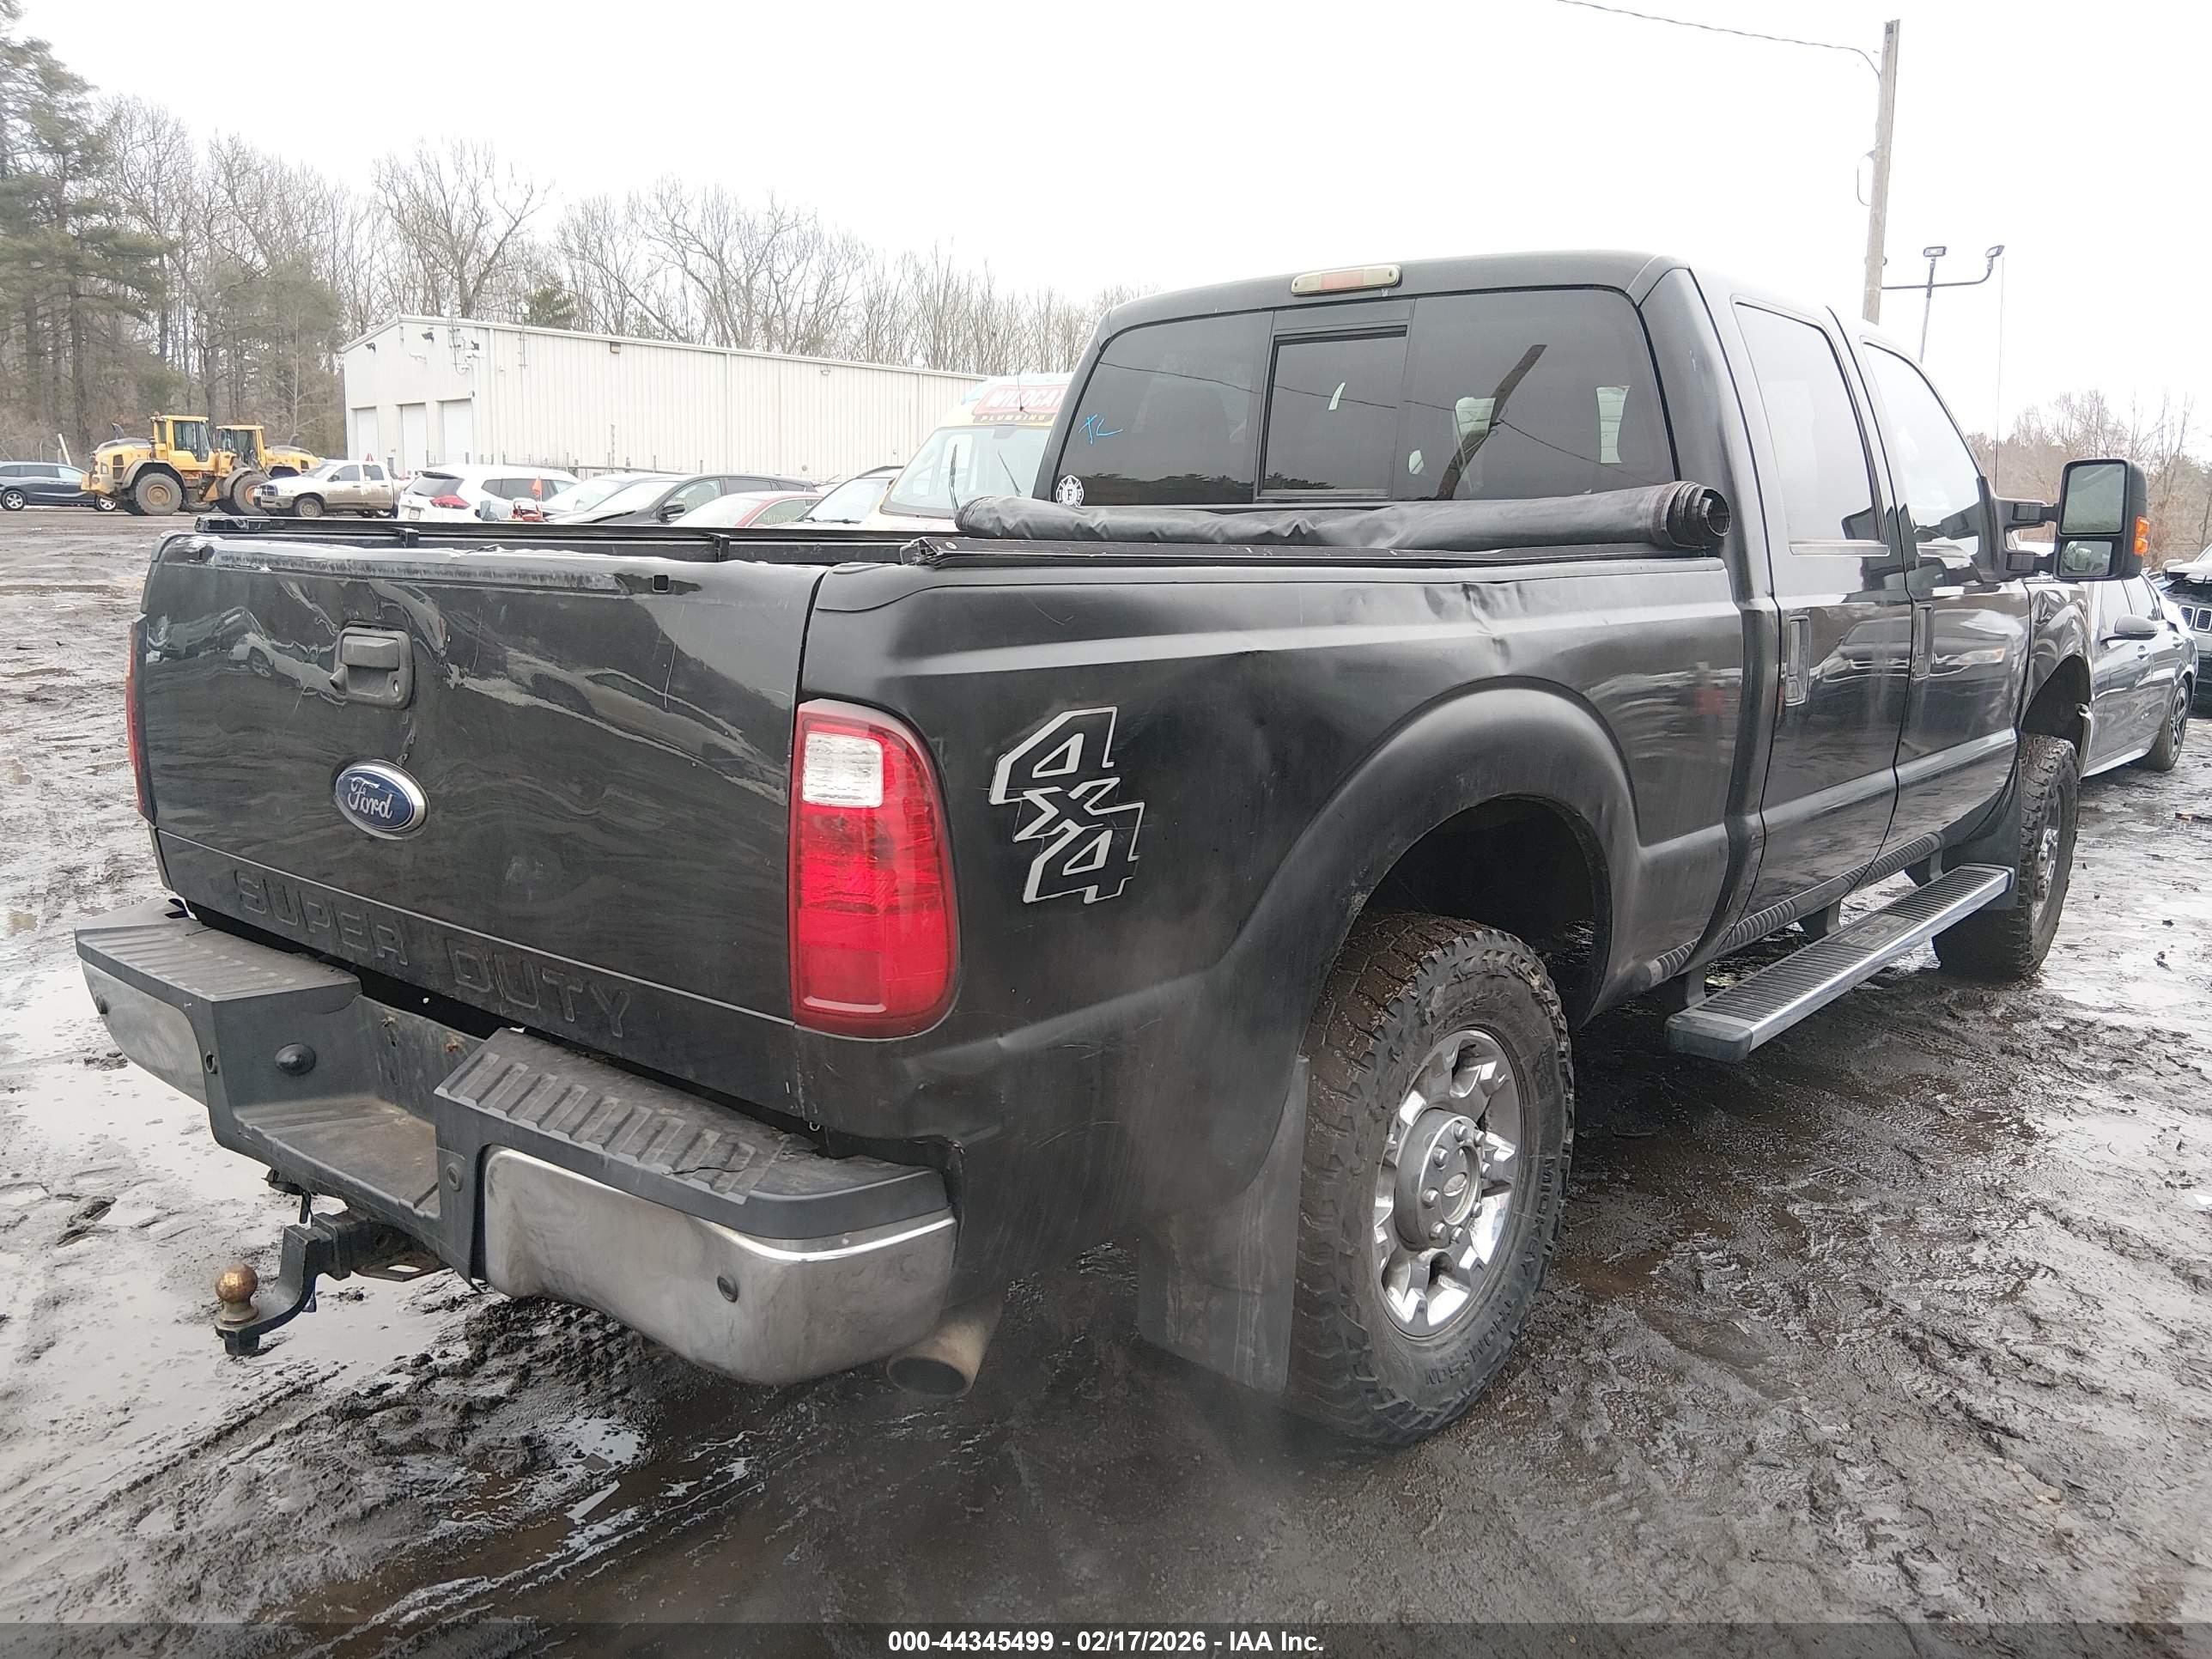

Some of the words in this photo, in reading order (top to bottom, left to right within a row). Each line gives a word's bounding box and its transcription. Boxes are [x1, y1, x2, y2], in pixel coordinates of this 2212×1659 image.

[981, 414, 1046, 422] PLUMBING
[347, 775, 394, 819] Ford
[234, 869, 409, 967] SUPER
[447, 939, 633, 1039] DUTY
[1520, 1157, 1556, 1276] MICKEY
